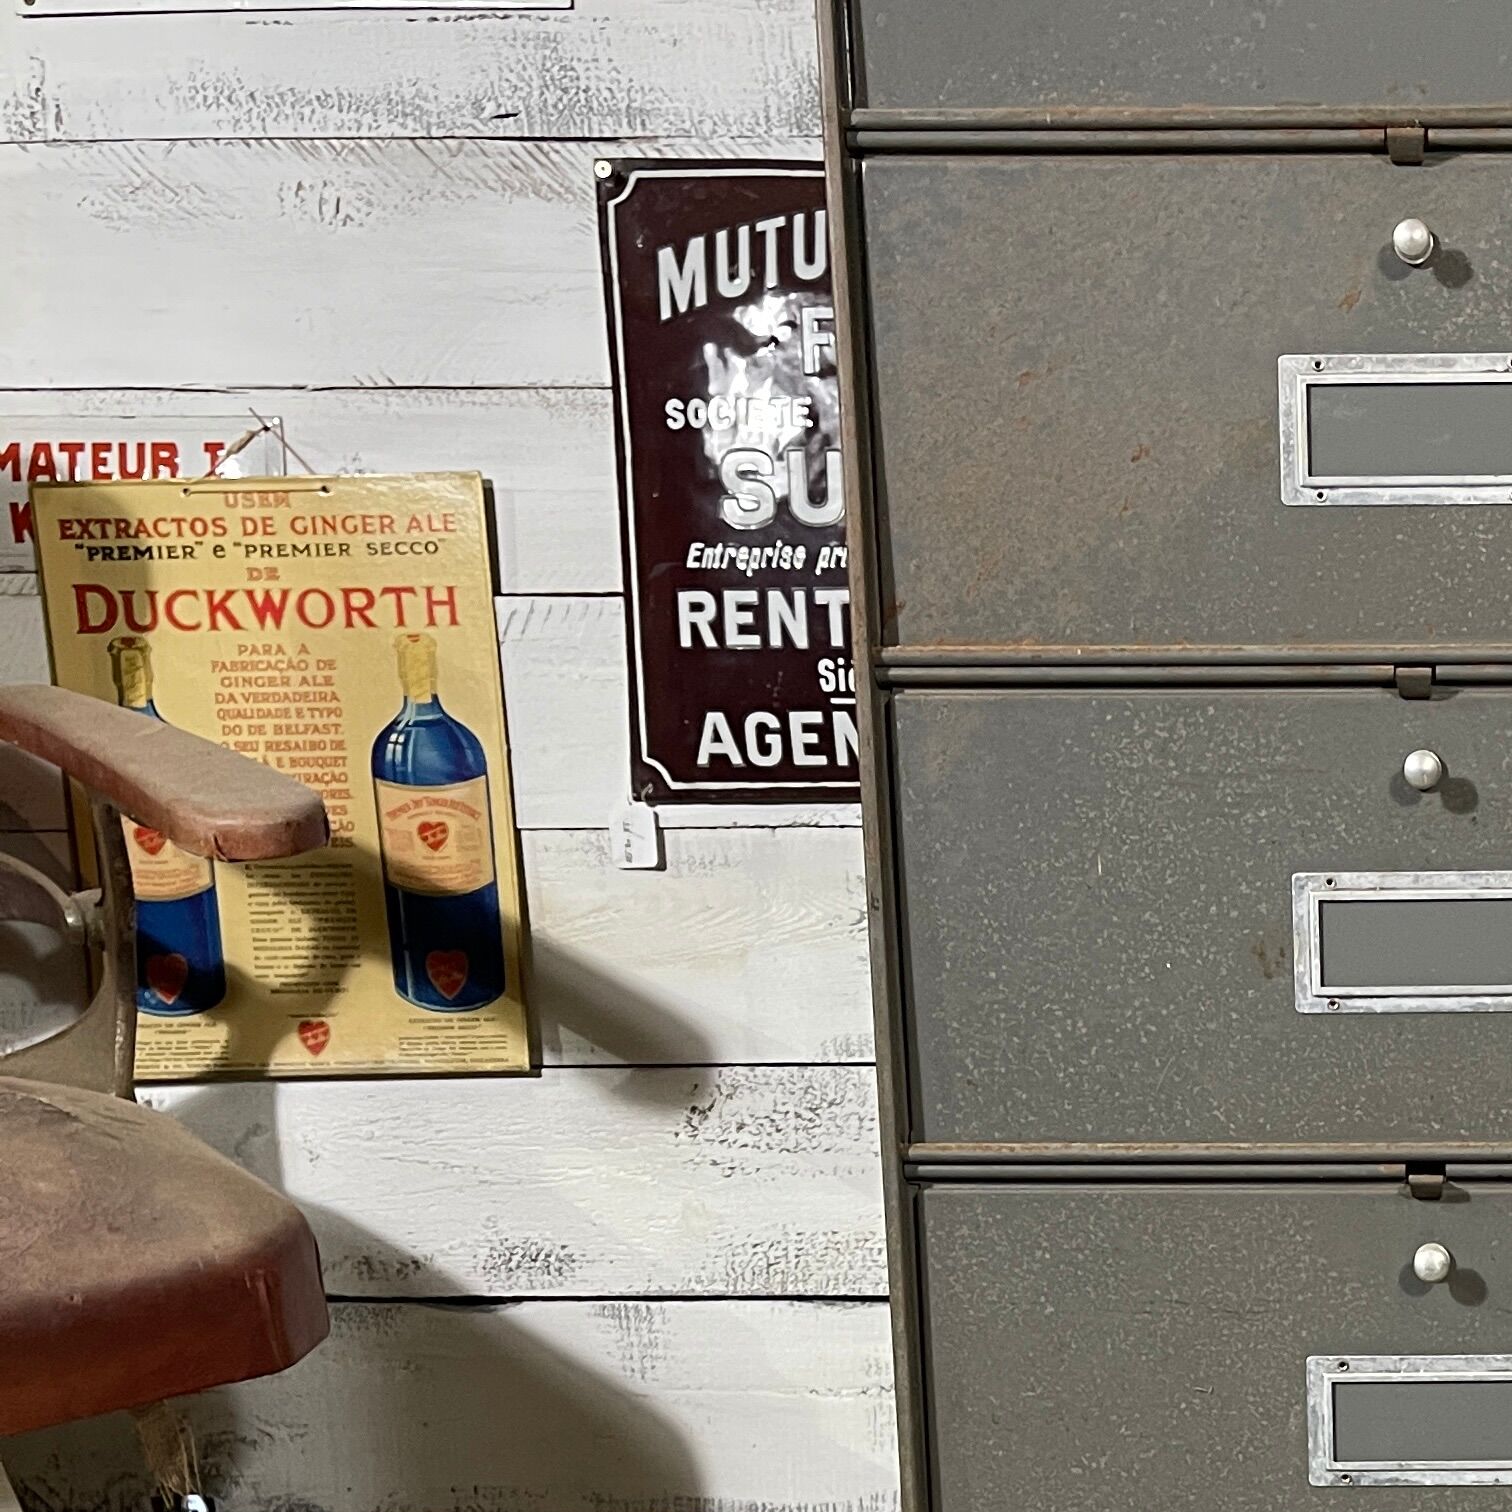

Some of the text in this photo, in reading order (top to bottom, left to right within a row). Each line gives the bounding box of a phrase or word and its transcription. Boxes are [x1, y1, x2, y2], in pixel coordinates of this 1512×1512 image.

[57, 512, 458, 541] EXTRACTOS DE GINGER ALE
[74, 540, 204, 562] "PREMIER"
[686, 541, 808, 578] Entreprise
[246, 566, 281, 582] DE
[72, 582, 462, 635] DUCKWORTH
[677, 588, 852, 650] RENT
[237, 642, 312, 657] PARA A
[211, 656, 338, 676] FABRICAÇÃO DE
[220, 674, 335, 689] GINGER ALE
[214, 690, 342, 705] DA VERDADEIRA
[216, 706, 293, 722] QUALIDADE
[221, 724, 243, 737] DO
[247, 724, 268, 736] DE
[289, 755, 348, 769] BOUQUET
